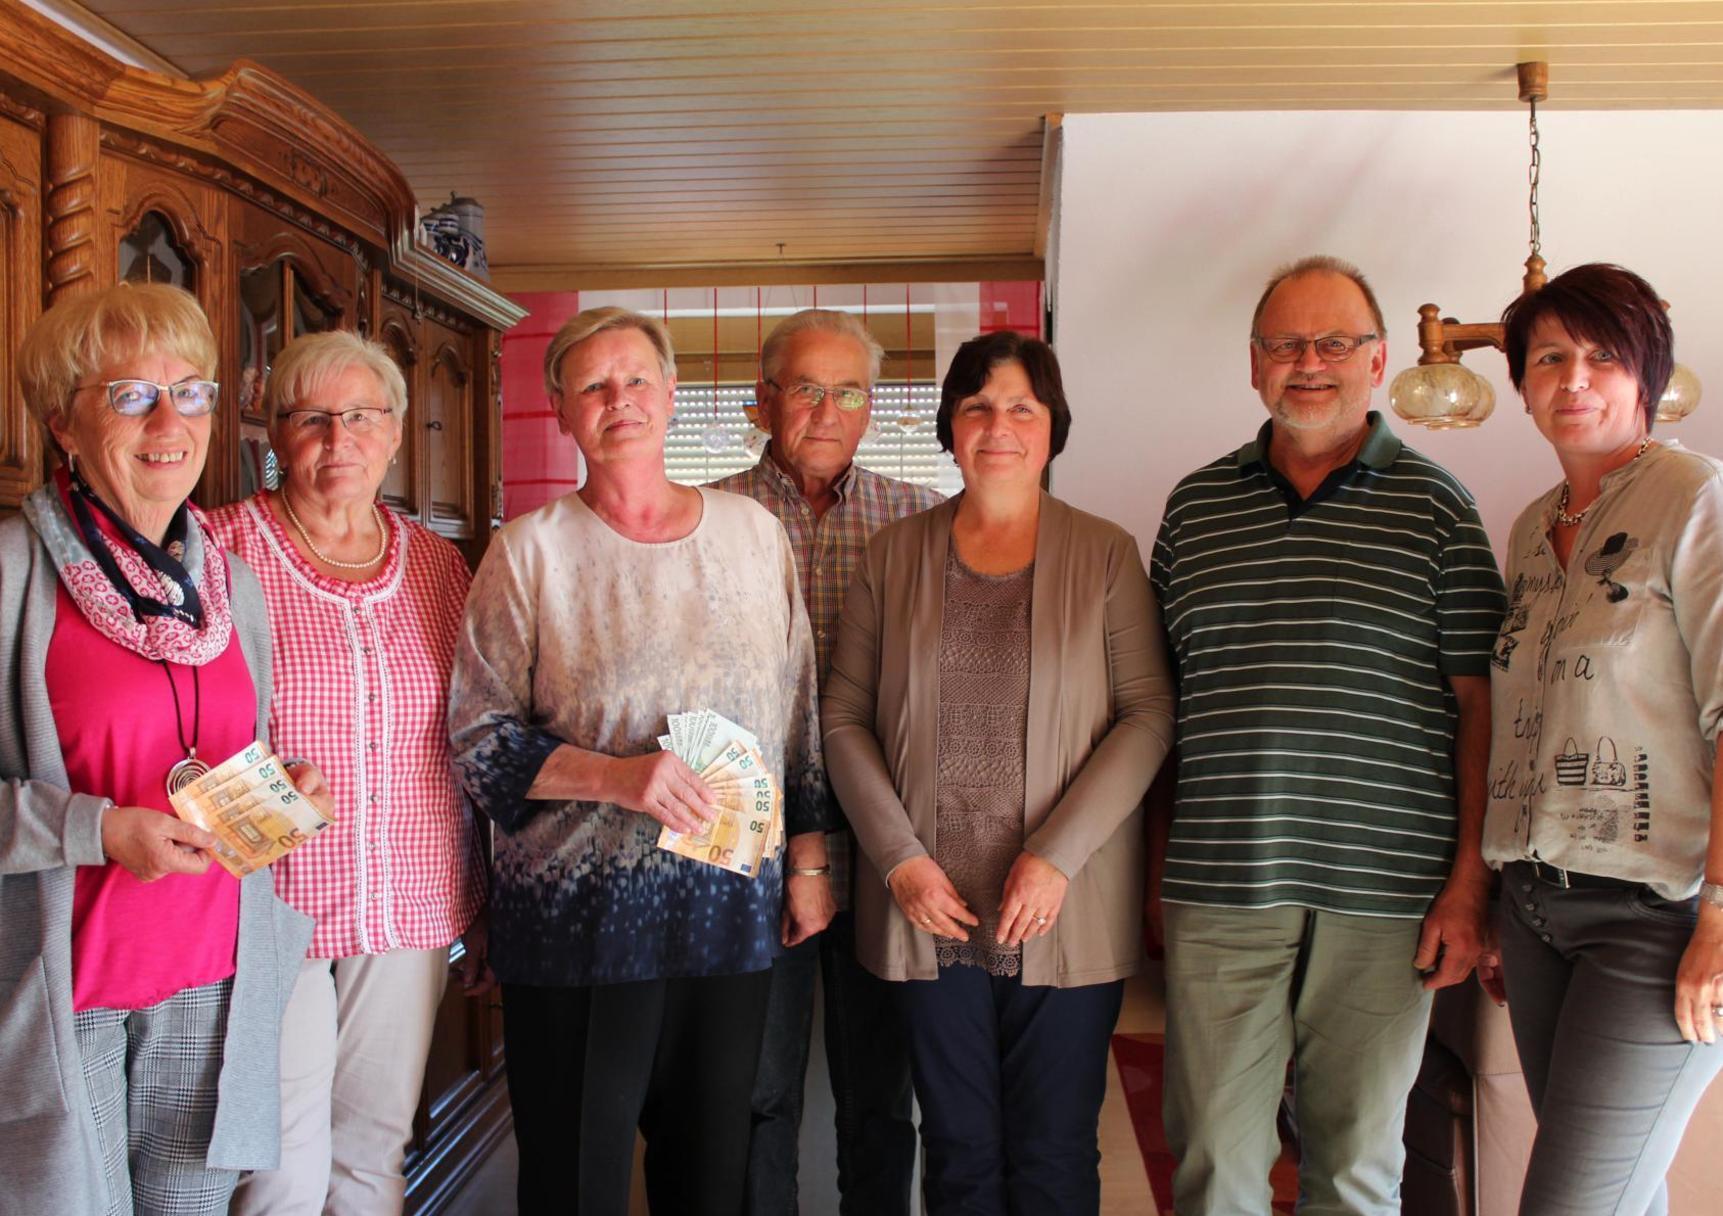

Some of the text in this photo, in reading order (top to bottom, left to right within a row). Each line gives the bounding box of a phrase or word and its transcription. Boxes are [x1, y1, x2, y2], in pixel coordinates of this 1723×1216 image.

[244, 747, 261, 764] 50
[739, 755, 753, 769] 50
[258, 763, 276, 778] 50
[269, 779, 288, 793] 50
[754, 778, 769, 789] 50
[281, 791, 299, 805] 50
[755, 800, 770, 812] 50
[750, 820, 765, 833] 50
[278, 827, 307, 849] 50
[708, 845, 734, 865] 50
